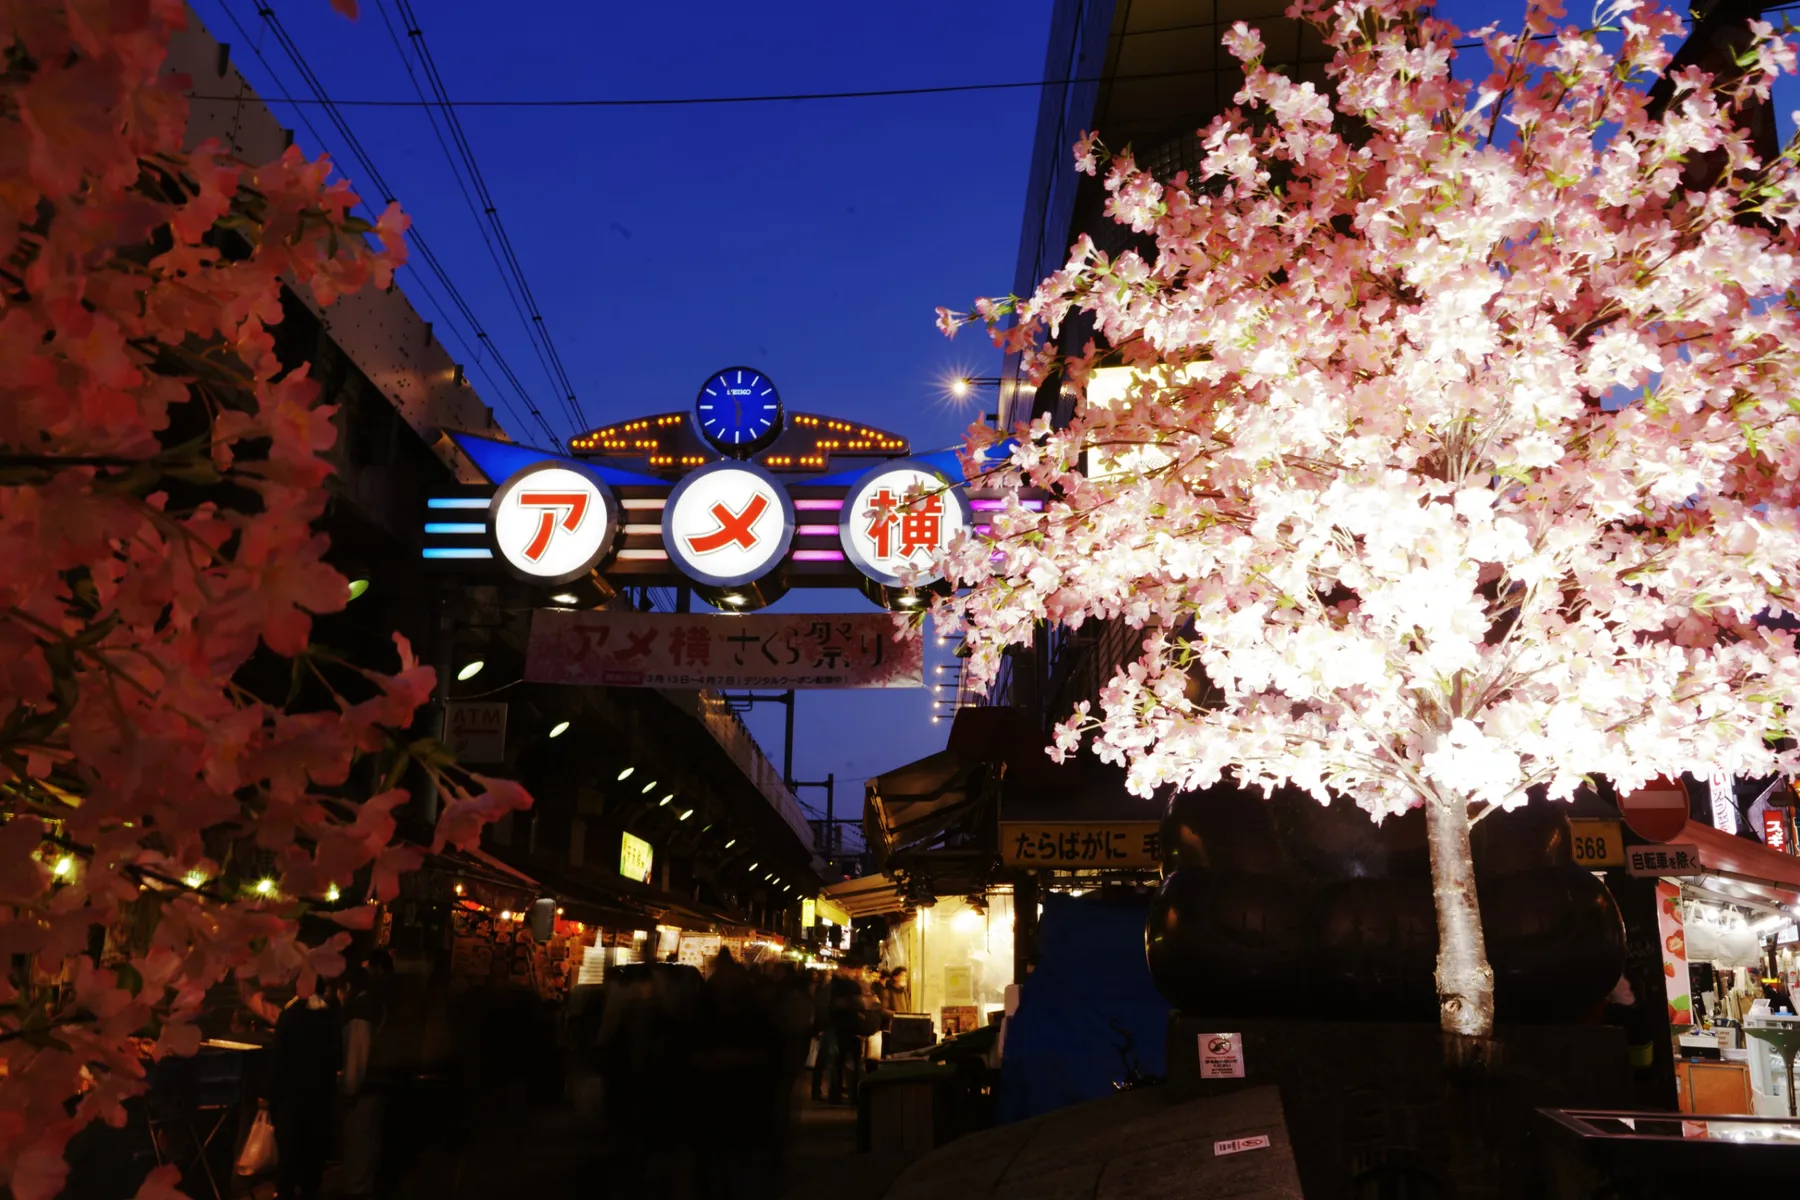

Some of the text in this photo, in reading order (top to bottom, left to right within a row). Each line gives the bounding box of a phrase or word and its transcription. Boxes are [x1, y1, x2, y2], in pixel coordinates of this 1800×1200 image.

[452, 708, 500, 725] ATM
[1015, 830, 1127, 861] たらばがに
[1766, 820, 1785, 852] スギ
[1632, 851, 1697, 870] 自転車を除く
